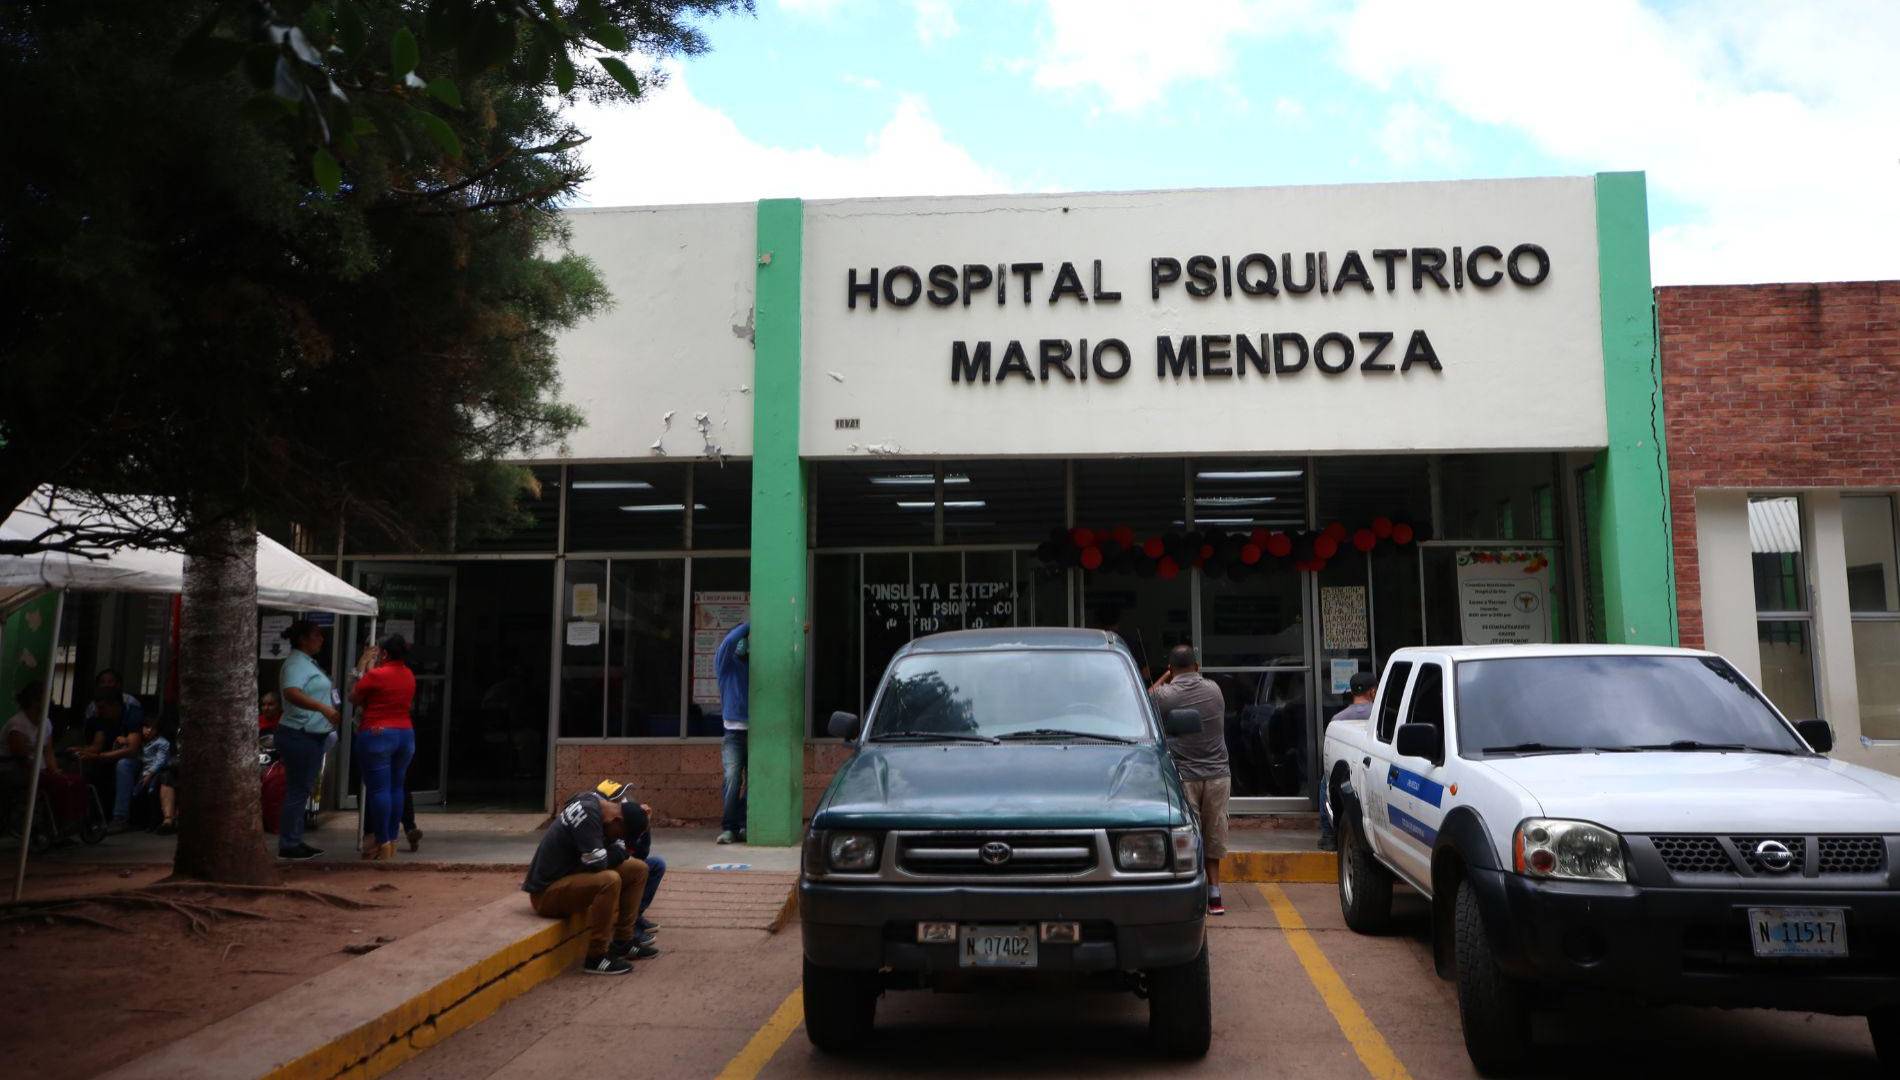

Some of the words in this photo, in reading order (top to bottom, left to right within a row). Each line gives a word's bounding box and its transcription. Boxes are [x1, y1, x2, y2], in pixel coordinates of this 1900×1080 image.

[848, 259, 1122, 309] HOSPITAL
[1151, 243, 1551, 300] PSIQUIATRICO
[951, 338, 1131, 383] MARIO
[1157, 329, 1443, 378] MENDOZA
[966, 937, 975, 956] N
[1759, 921, 1771, 943] N
[1782, 921, 1836, 944] 11517
